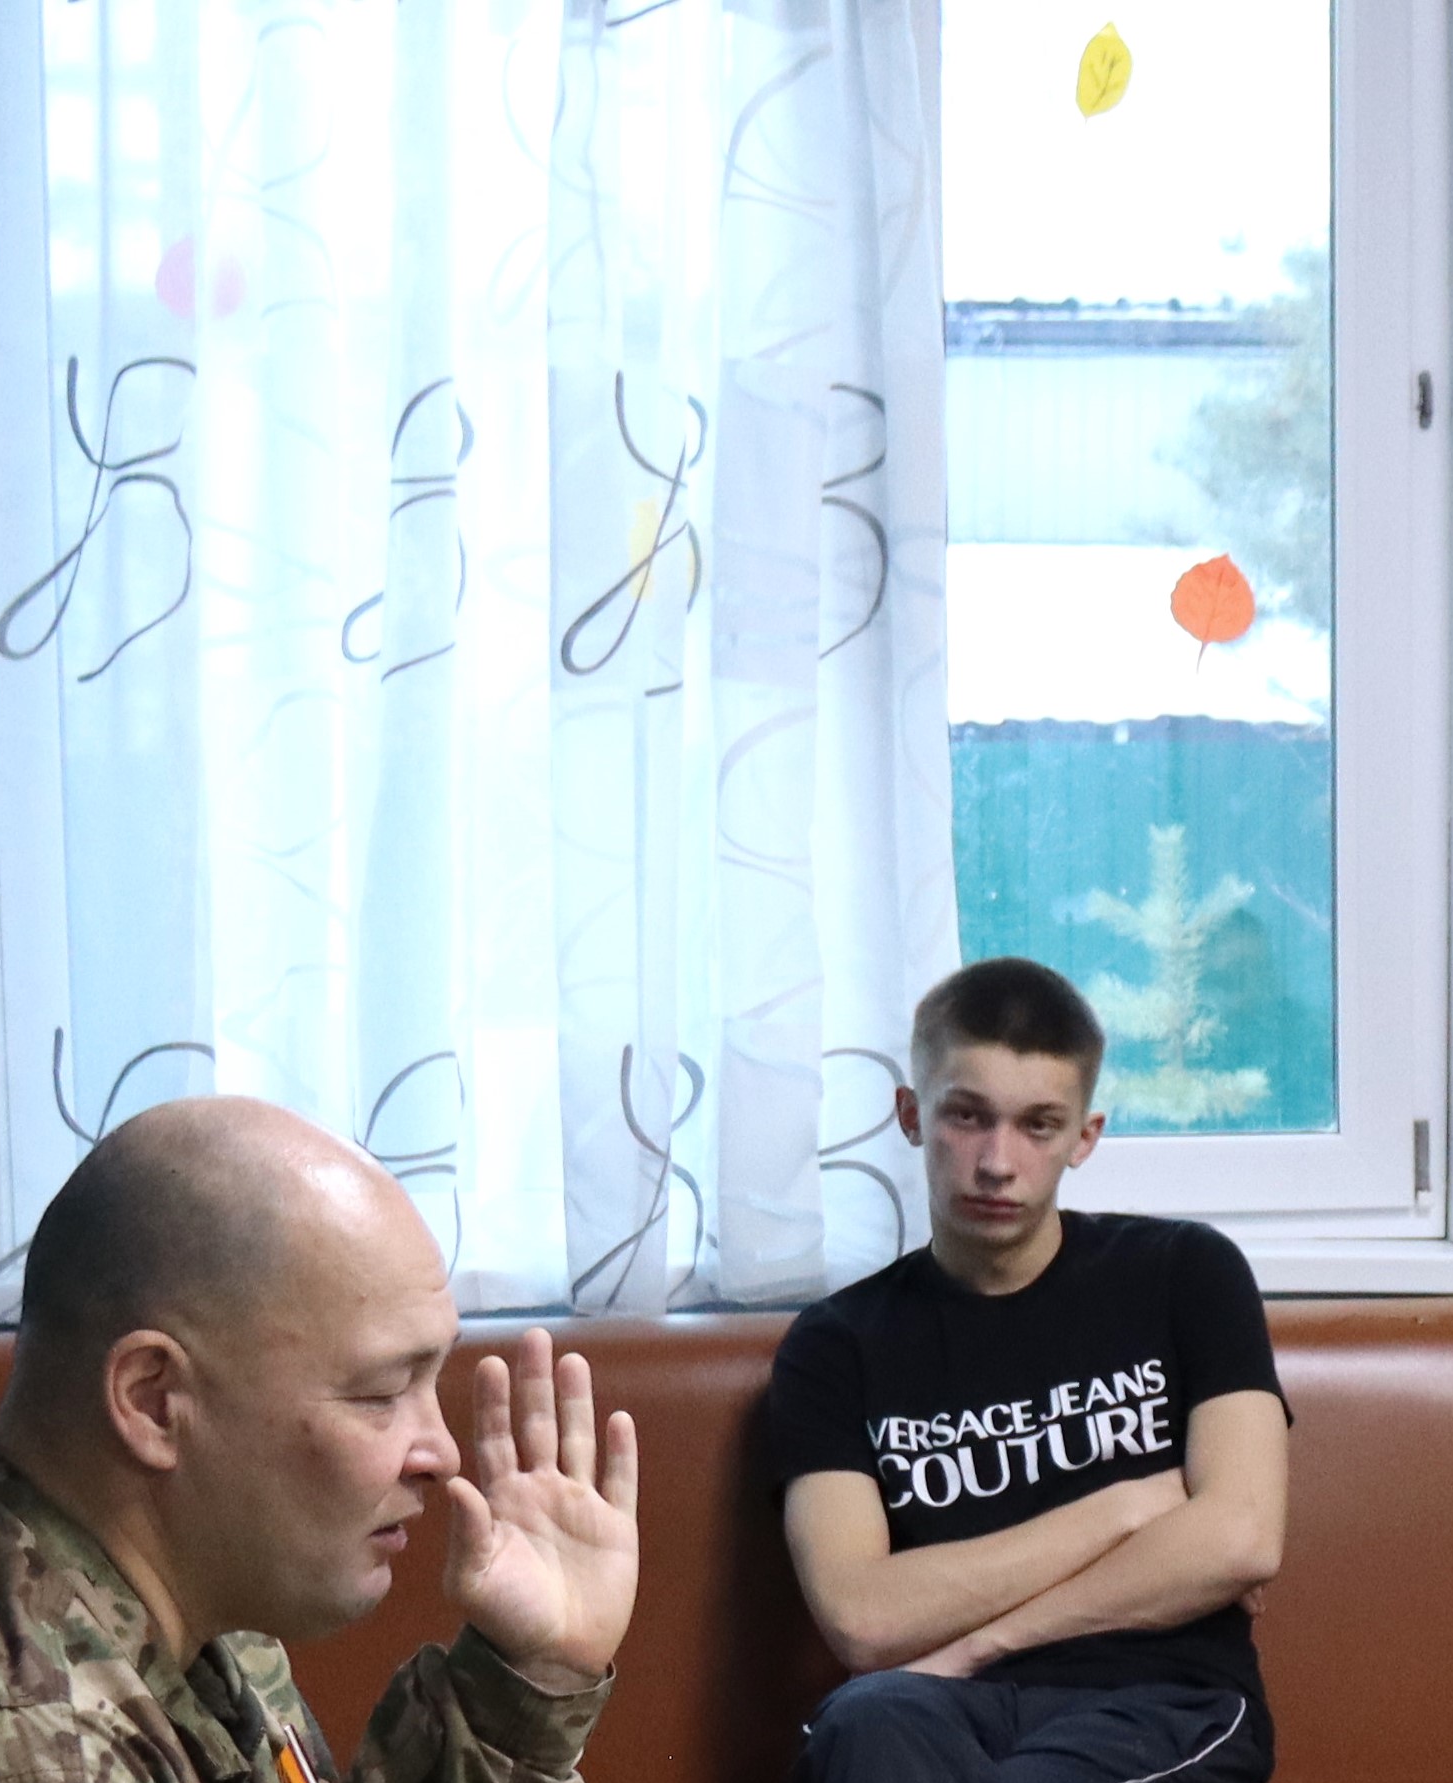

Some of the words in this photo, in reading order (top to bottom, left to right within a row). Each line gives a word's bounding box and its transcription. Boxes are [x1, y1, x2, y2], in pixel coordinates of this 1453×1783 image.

[866, 1399, 1038, 1452] VERSACE
[1039, 1358, 1167, 1422] JEANS
[877, 1396, 1173, 1509] COUTURE
